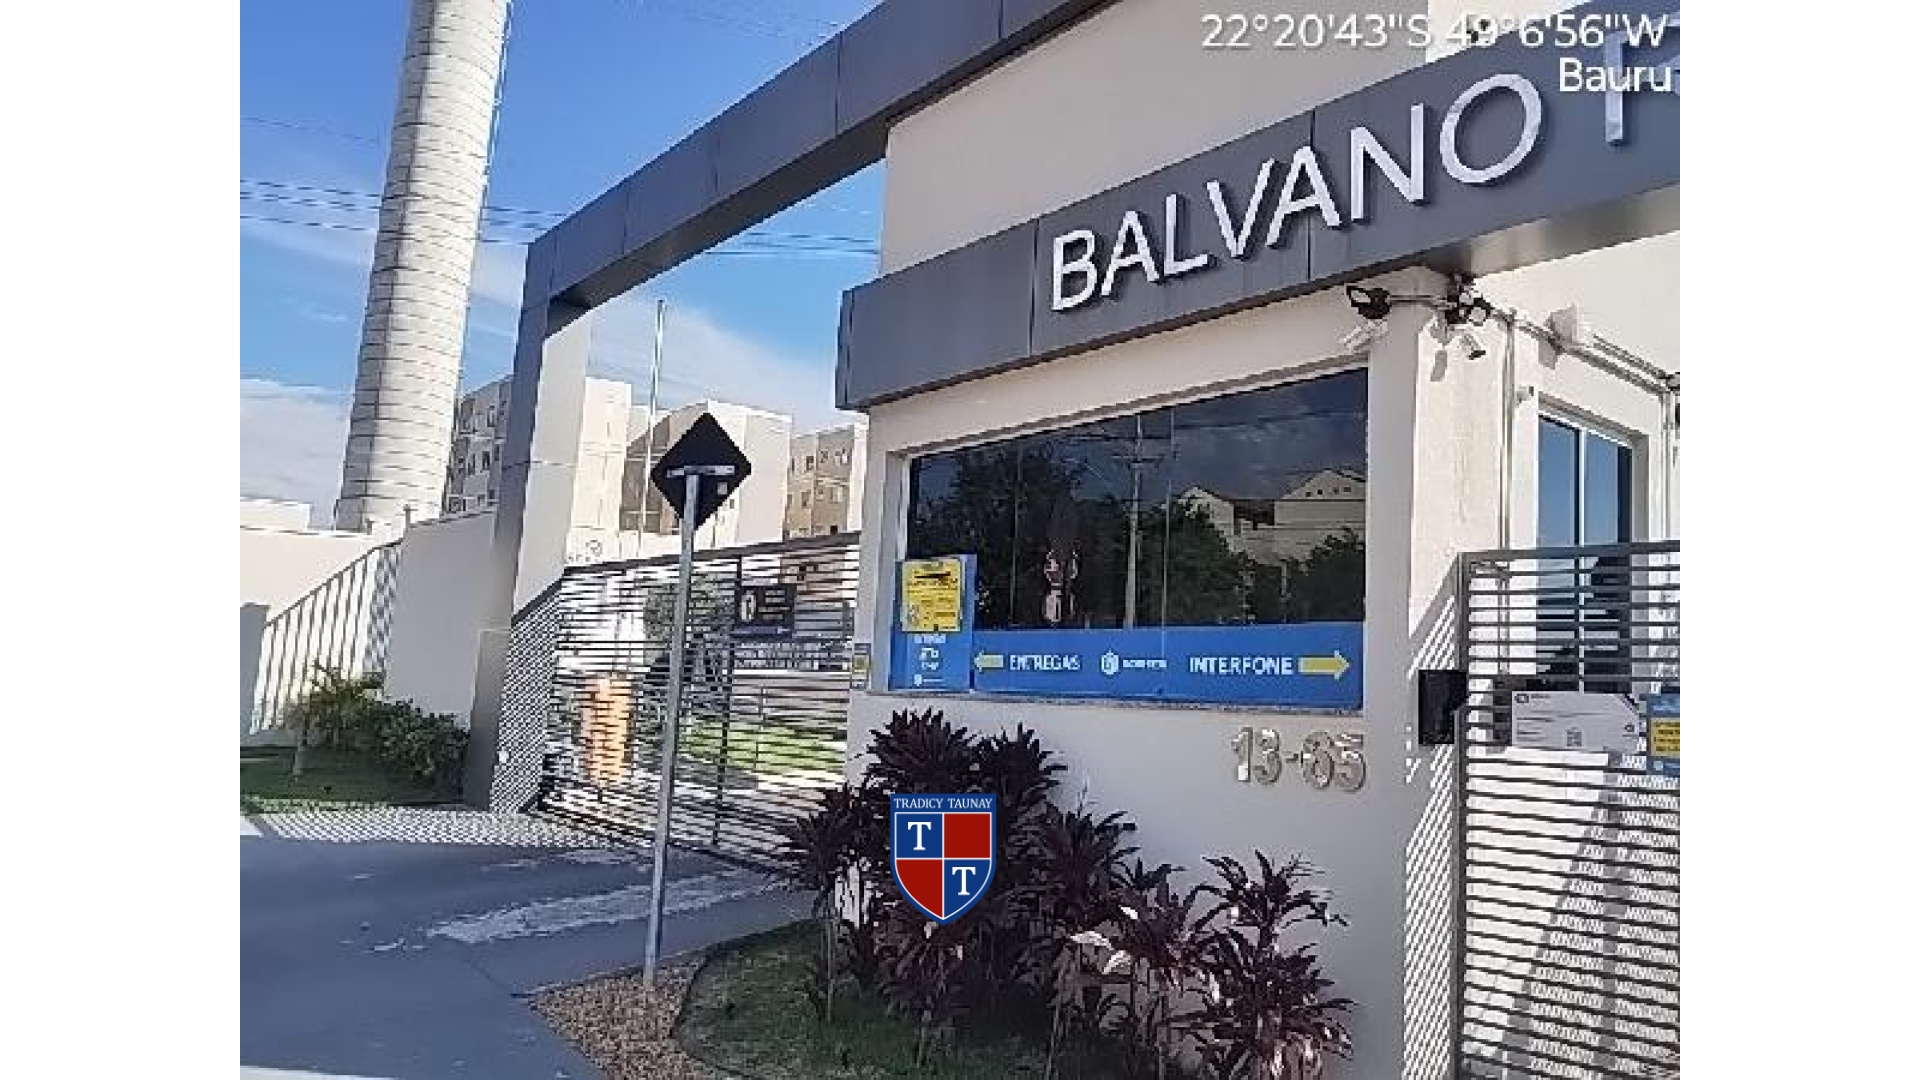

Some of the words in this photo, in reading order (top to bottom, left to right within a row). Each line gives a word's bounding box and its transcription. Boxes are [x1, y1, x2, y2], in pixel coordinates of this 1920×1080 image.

[1051, 72, 1542, 313] BALVANO
[1009, 654, 1081, 671] ENTREGAS
[1189, 656, 1294, 676] INTERFONE
